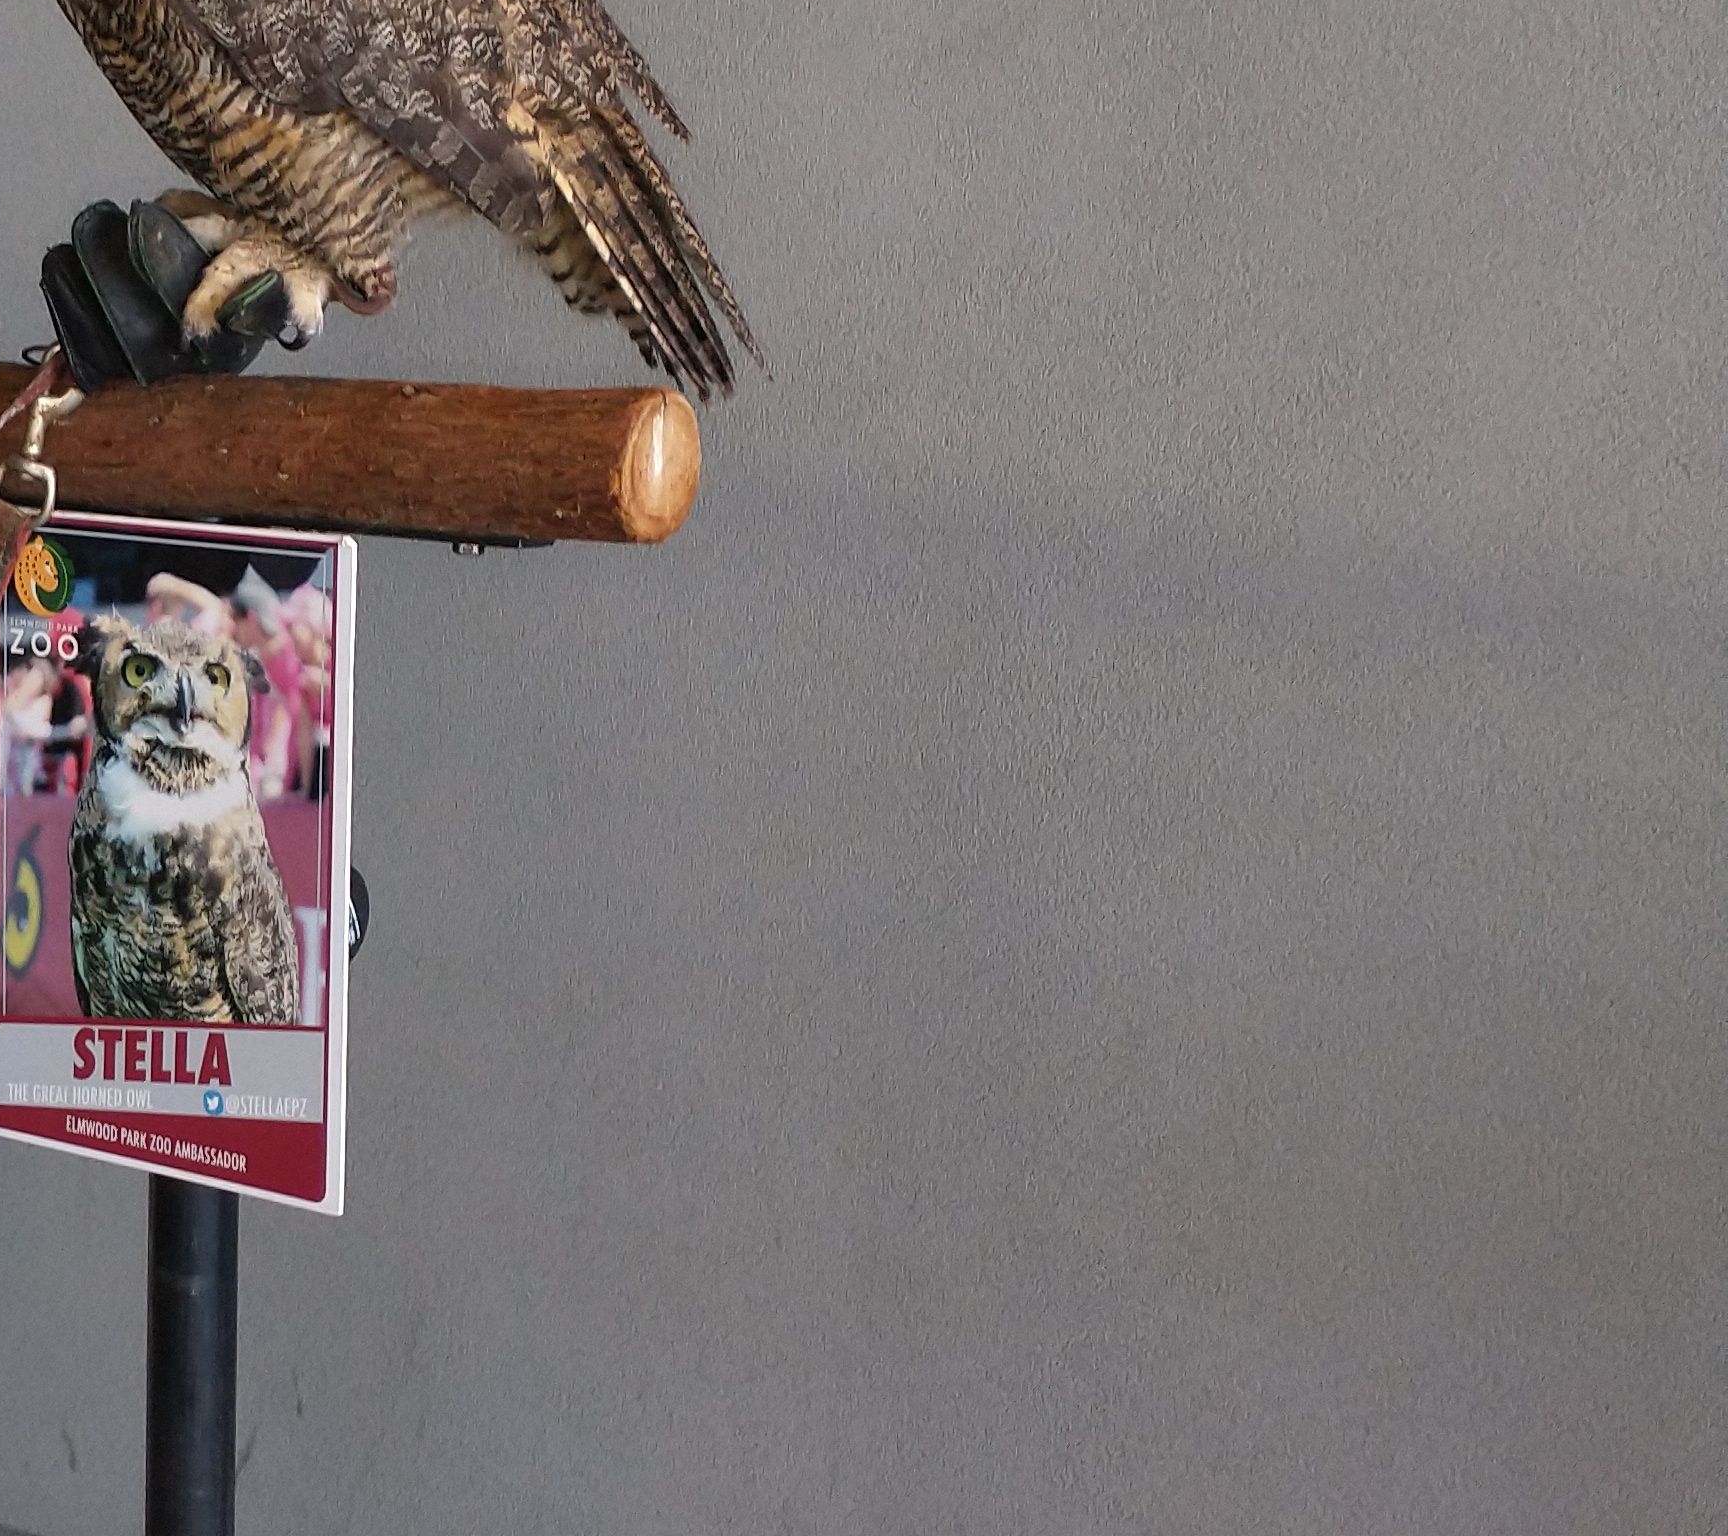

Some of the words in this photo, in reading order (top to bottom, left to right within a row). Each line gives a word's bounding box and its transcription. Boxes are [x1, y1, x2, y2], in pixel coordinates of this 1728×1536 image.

[10, 627, 79, 661] ZOO
[73, 1027, 232, 1086] STELLA
[8, 1082, 28, 1102] THE
[32, 1084, 69, 1104] GREAT
[72, 1085, 122, 1107] HORNED
[126, 1088, 153, 1110] OWL
[66, 1114, 119, 1143] ELMWOOD
[120, 1126, 147, 1150] PARK
[149, 1133, 172, 1157] ZOO
[174, 1139, 248, 1174] AMBASSADOR
